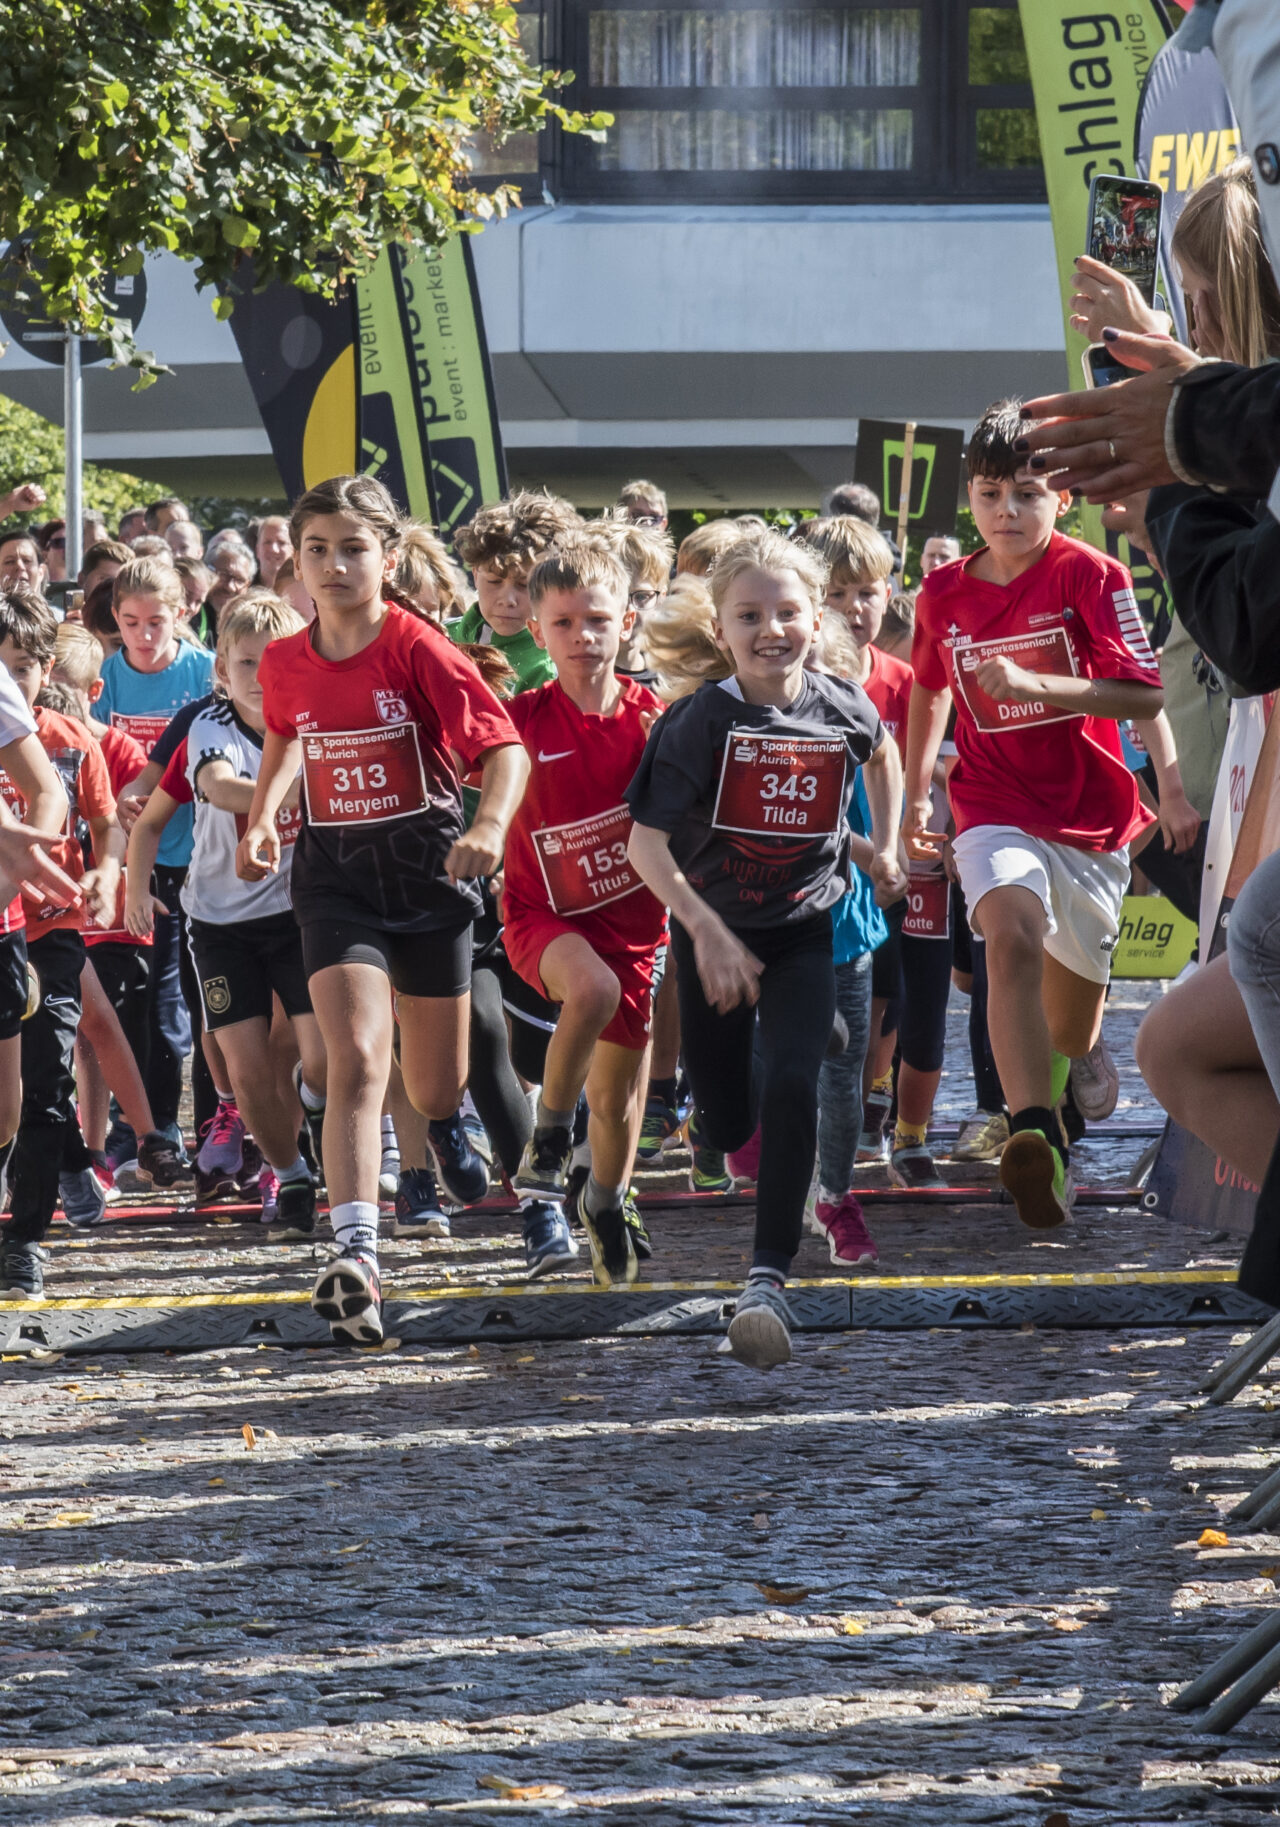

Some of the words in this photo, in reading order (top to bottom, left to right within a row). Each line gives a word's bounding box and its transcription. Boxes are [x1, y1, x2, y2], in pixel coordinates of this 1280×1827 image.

[443, 357, 467, 422] event
[980, 634, 1056, 657] Sparkassenlauf
[323, 727, 406, 747] Sparkassenlauf
[761, 740, 845, 753] Sparkassenlauf
[325, 749, 358, 760] Aurich
[759, 755, 797, 766] Aurich
[332, 764, 388, 792] 313
[760, 774, 818, 801] 343
[329, 794, 400, 815] Meryem
[561, 809, 631, 840] Sparkassenla
[762, 806, 808, 825] Tilda
[566, 834, 600, 851] Aurich
[577, 842, 628, 878] 153
[588, 872, 630, 897] Titus
[1127, 949, 1165, 958] service
